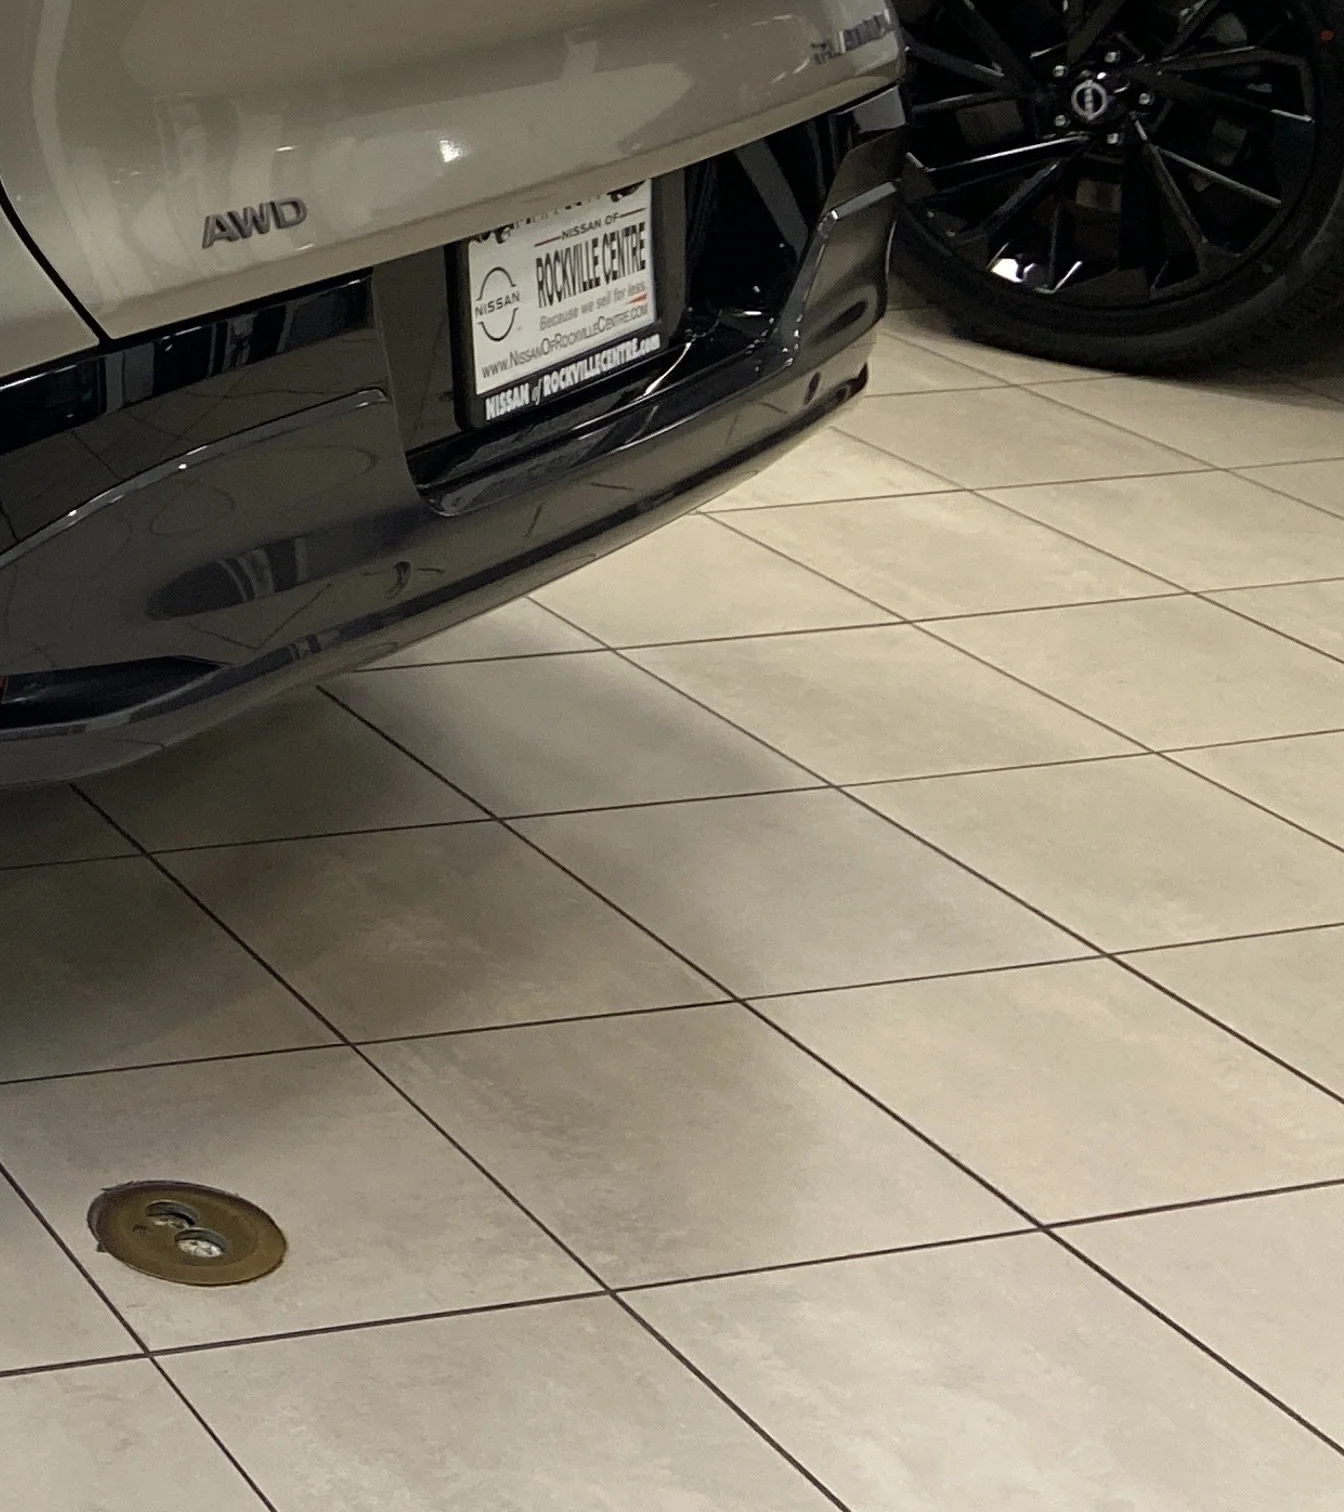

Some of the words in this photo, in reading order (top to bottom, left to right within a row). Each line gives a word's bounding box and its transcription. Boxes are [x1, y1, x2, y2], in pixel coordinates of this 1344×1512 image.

[201, 197, 308, 249] AWD
[562, 219, 601, 240] NISSAN
[604, 212, 619, 225] OF
[536, 238, 601, 308] ROCKVILLE
[603, 222, 646, 285] CENTRE
[474, 290, 520, 317] NISSAN
[540, 306, 579, 331] Because
[485, 382, 530, 420] NISSAN
